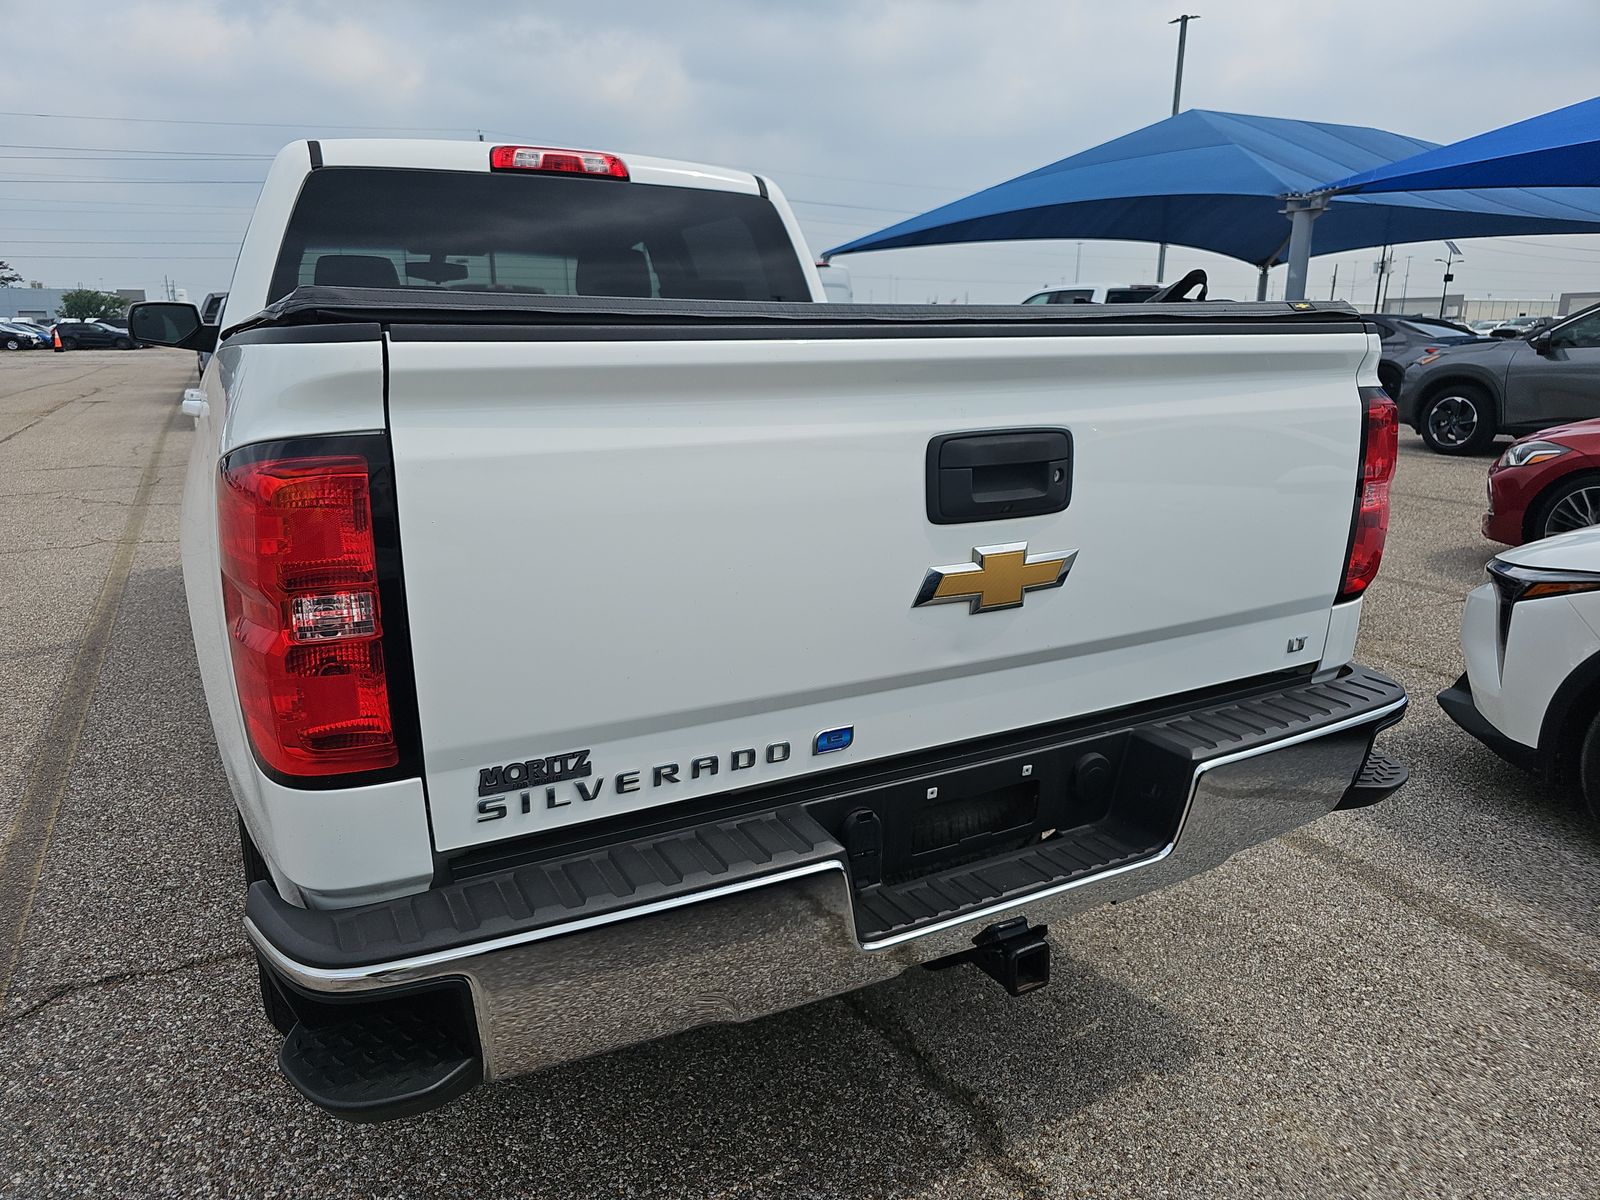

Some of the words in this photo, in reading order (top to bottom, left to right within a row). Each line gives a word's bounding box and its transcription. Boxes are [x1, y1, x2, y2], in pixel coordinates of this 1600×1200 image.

[1287, 636, 1308, 653] LT
[476, 740, 791, 823] SILVERADO
[479, 749, 592, 789] MORITZ
